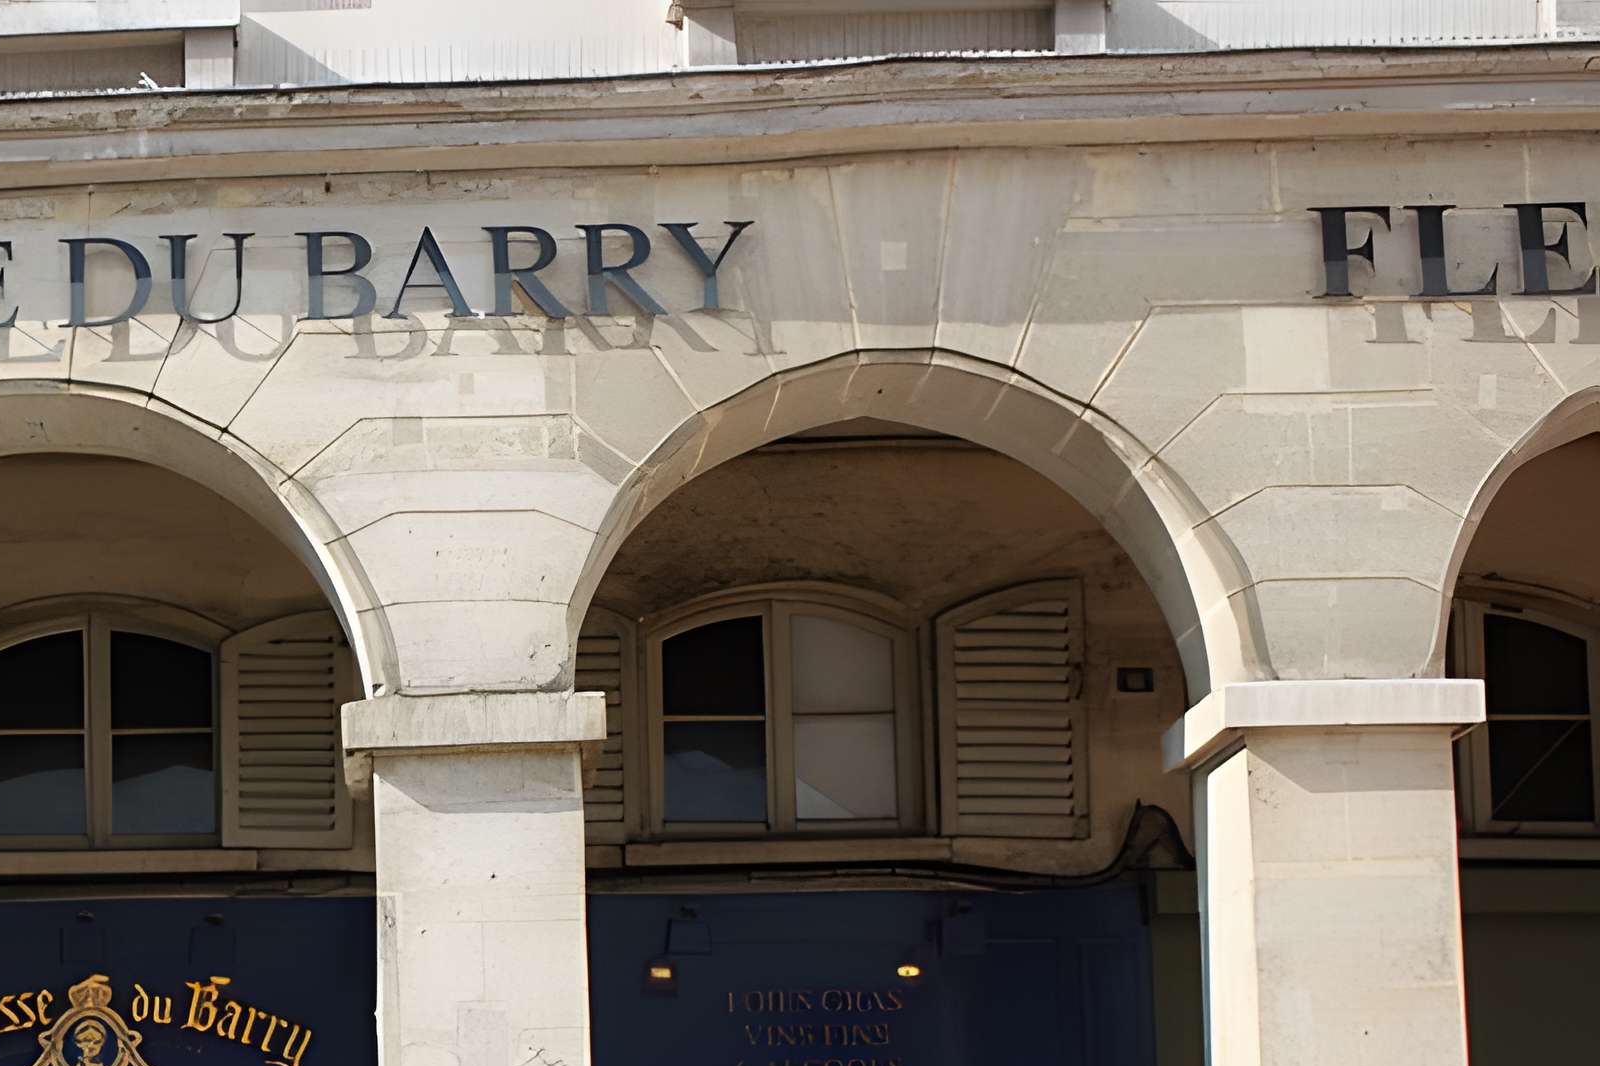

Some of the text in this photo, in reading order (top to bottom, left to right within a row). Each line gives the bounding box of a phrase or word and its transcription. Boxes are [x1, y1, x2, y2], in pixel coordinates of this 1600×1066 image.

[58, 232, 255, 328] DU
[295, 220, 755, 321] BARRY
[132, 983, 172, 1025] du
